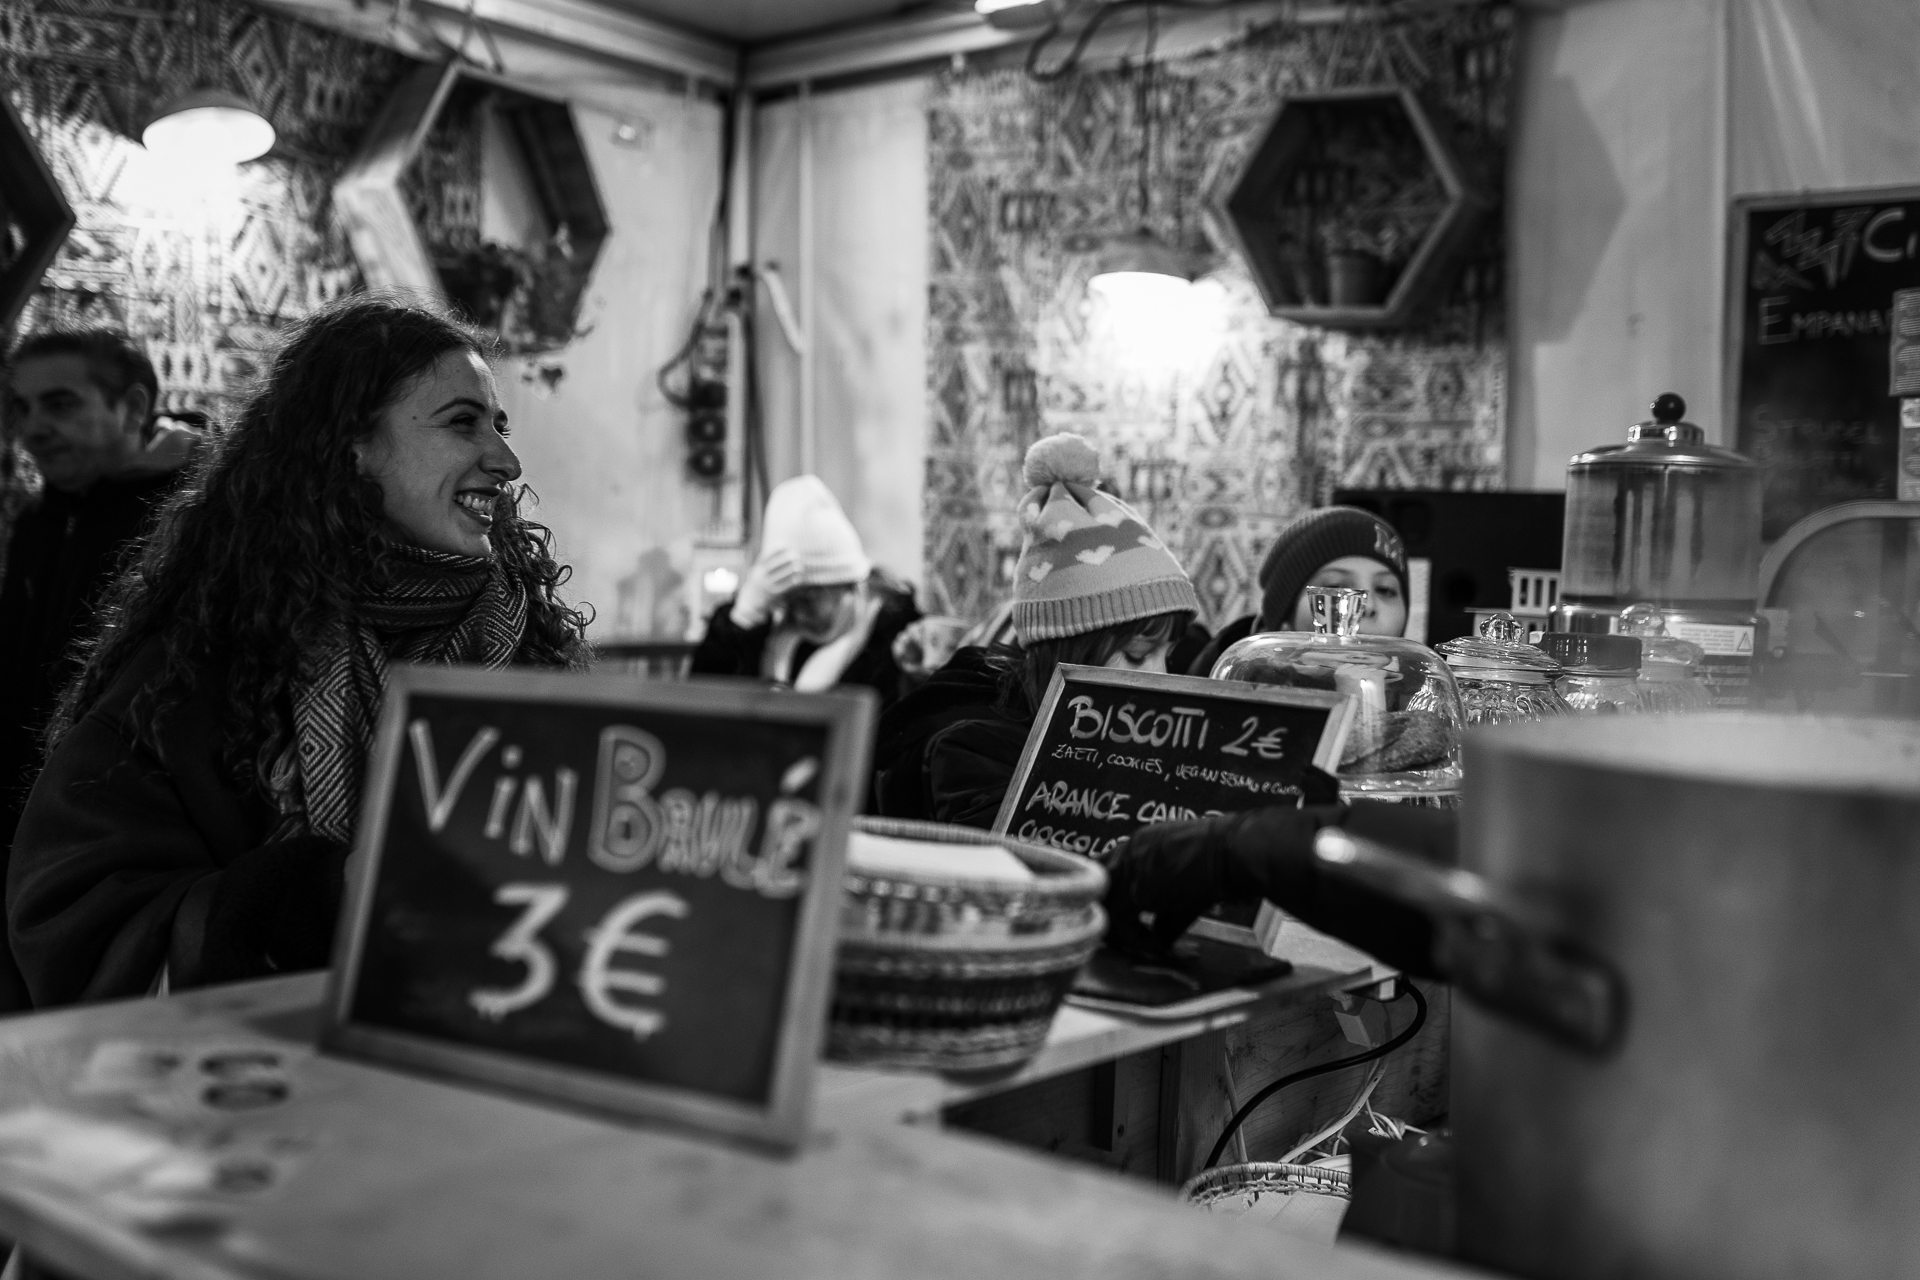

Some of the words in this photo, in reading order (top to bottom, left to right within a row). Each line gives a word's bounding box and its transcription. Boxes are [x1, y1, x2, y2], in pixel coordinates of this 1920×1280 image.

[1758, 295, 1893, 345] EMPANA
[1067, 695, 1209, 750] BISCOTTI
[1175, 763, 1219, 783] VEGAN
[1025, 780, 1131, 821] ARANCE
